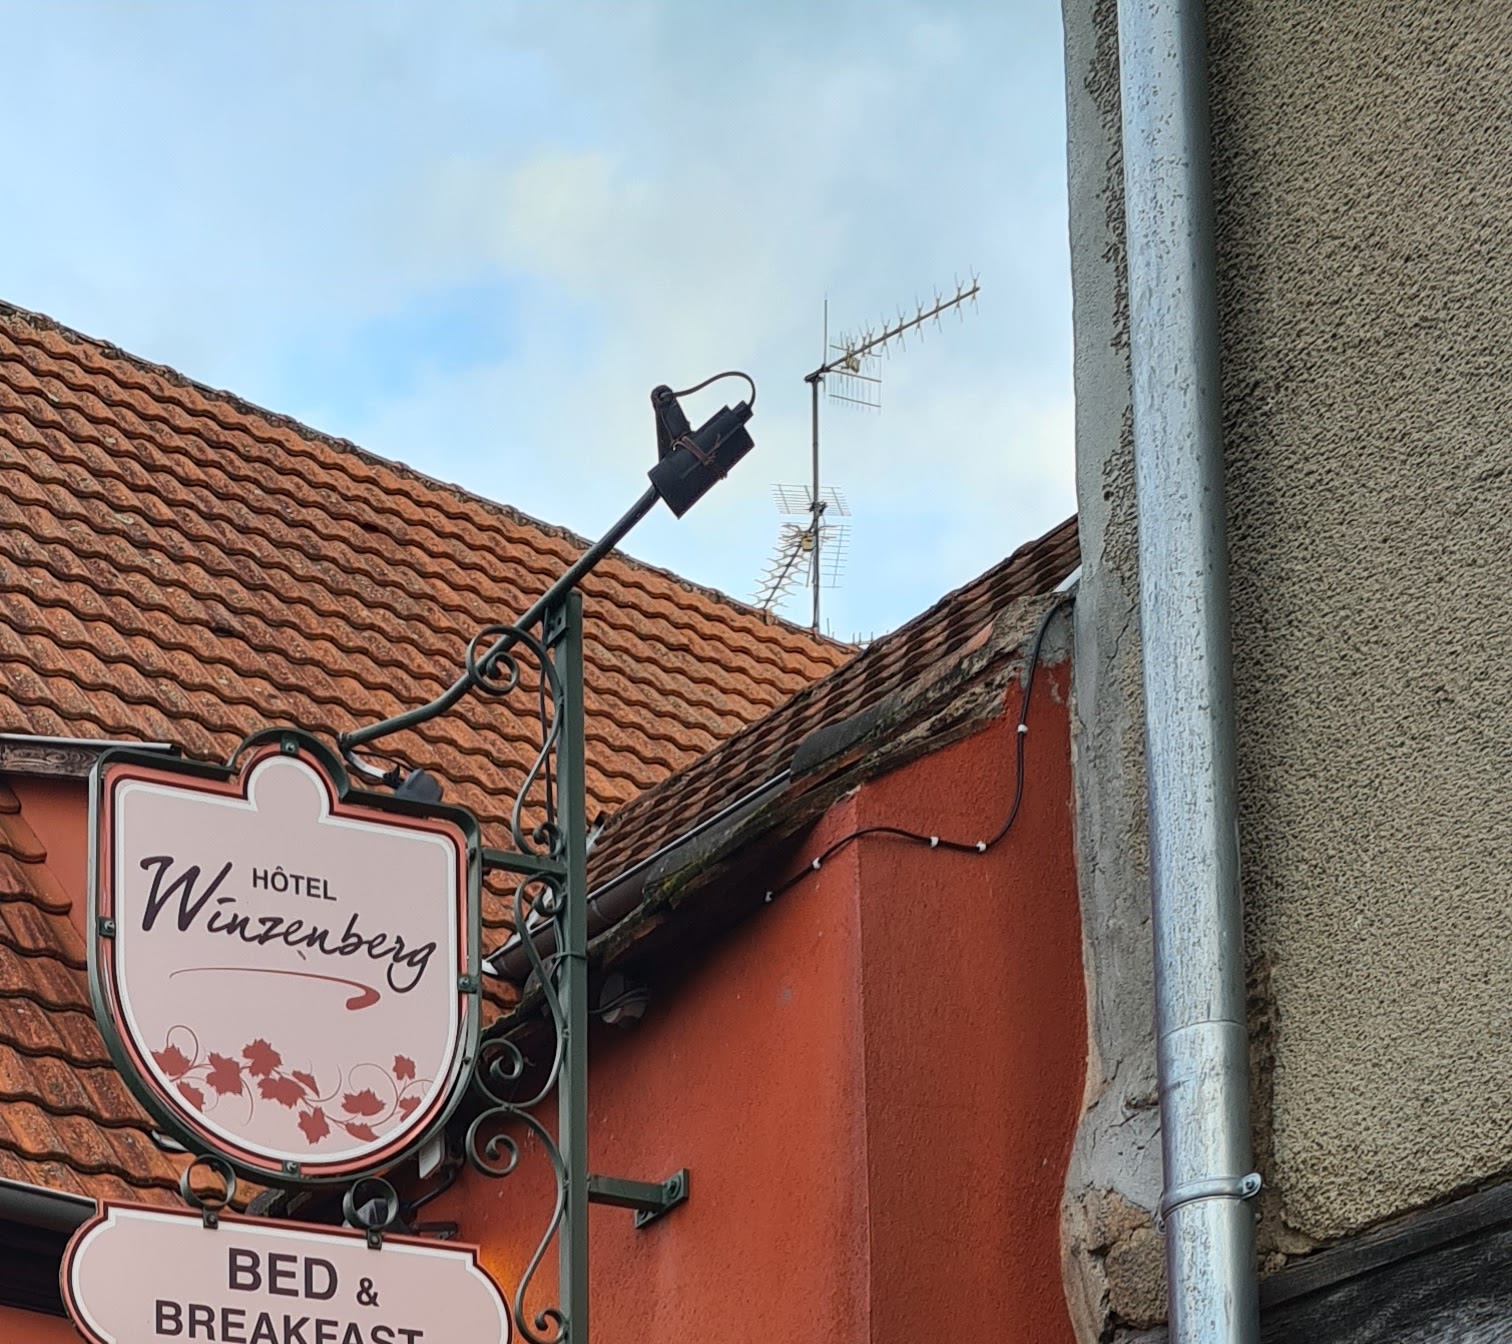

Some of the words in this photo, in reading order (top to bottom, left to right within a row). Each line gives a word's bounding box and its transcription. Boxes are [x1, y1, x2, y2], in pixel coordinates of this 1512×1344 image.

[252, 866, 337, 901] HÔTEL
[140, 856, 437, 993] Winzenberg
[229, 1247, 338, 1300] BED
[356, 1277, 380, 1307] &
